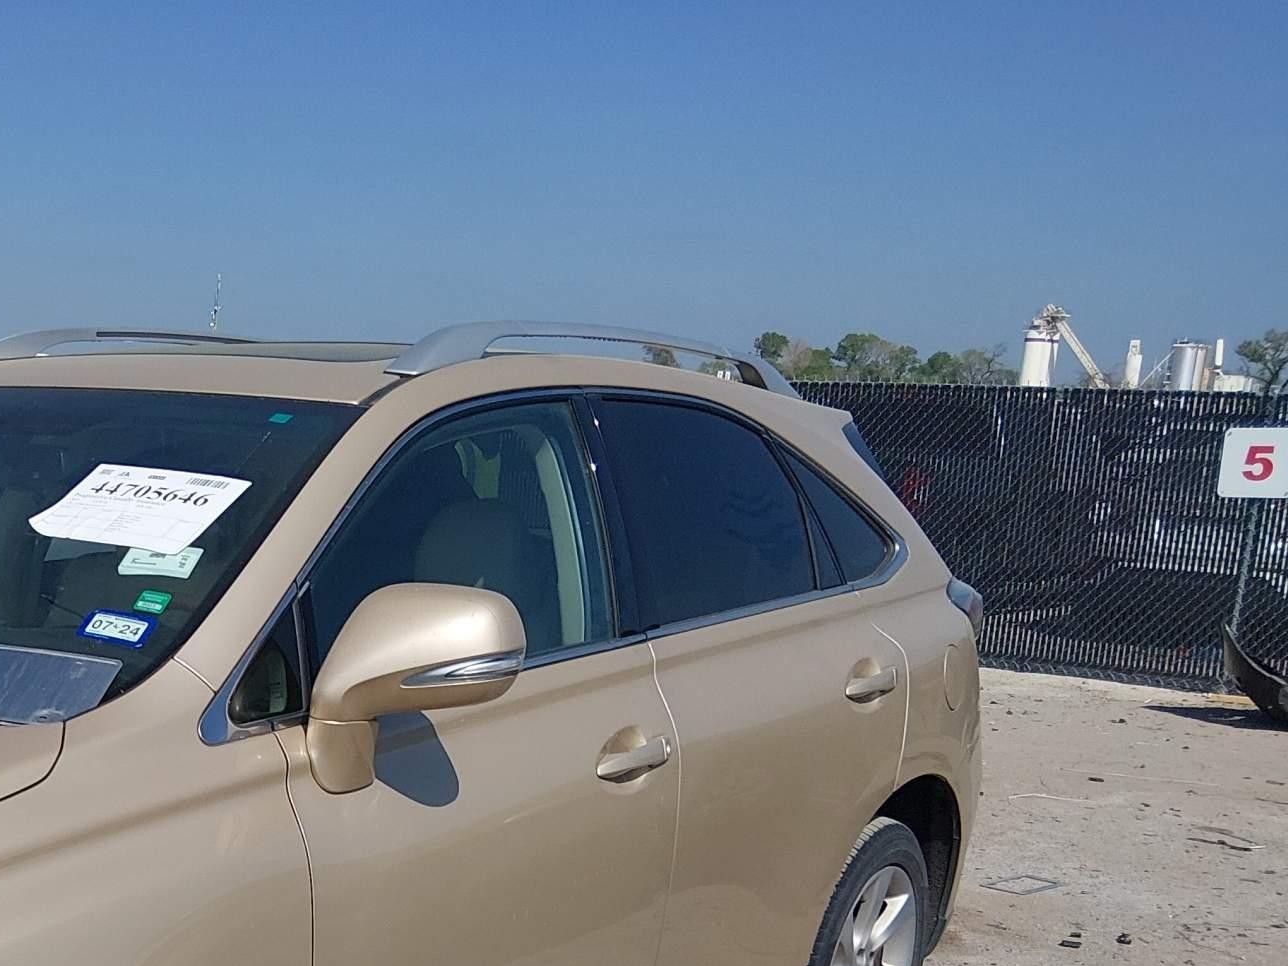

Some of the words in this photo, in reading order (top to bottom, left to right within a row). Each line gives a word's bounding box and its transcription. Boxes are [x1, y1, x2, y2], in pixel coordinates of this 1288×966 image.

[1242, 446, 1274, 482] 5
[90, 481, 215, 507] 44705646
[91, 619, 114, 632] 07
[117, 624, 141, 637] 24
